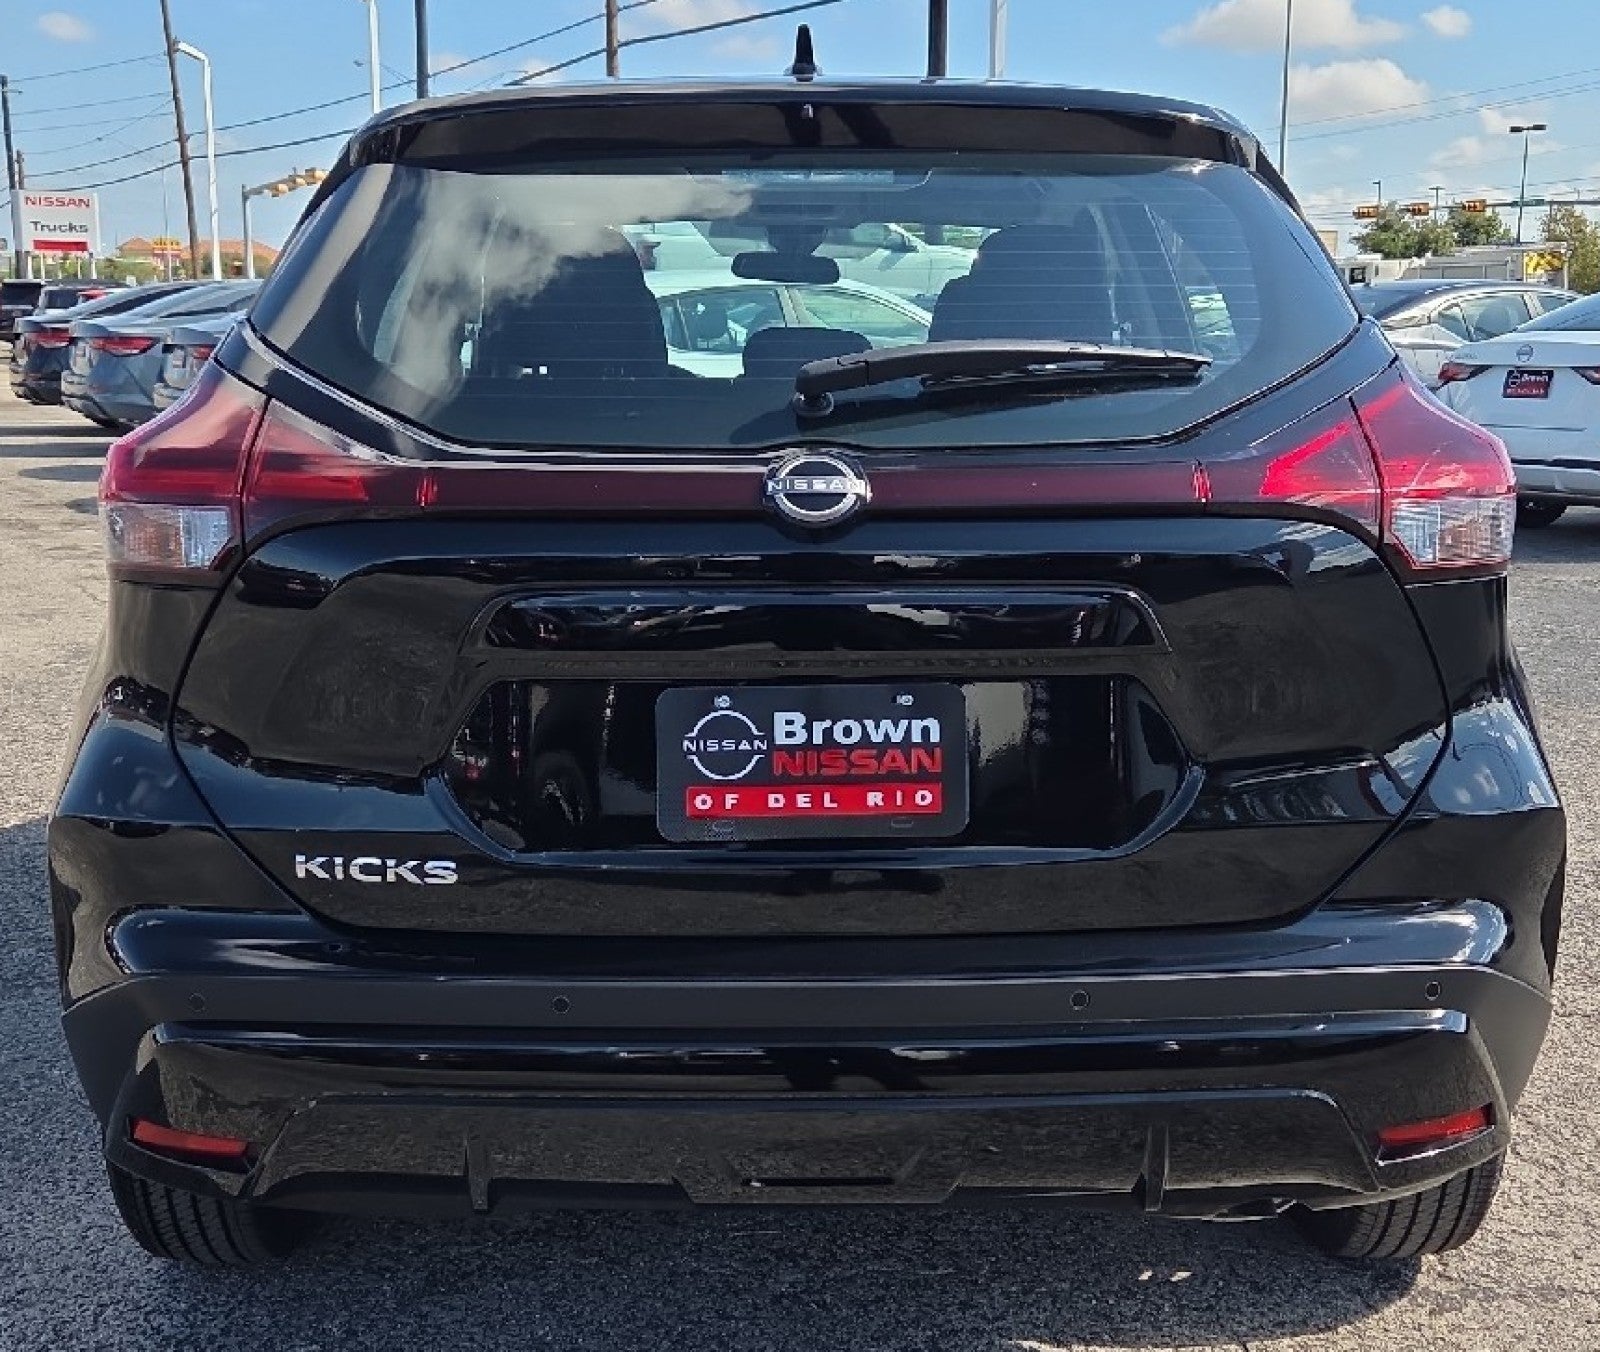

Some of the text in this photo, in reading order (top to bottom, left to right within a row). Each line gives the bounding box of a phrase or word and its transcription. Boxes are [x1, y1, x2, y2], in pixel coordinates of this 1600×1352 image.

[24, 196, 90, 208] NISSAN
[30, 221, 88, 233] Trucks
[766, 479, 866, 493] NISSAN
[773, 711, 941, 745] Brown
[682, 738, 768, 752] NISSAN
[773, 747, 943, 776] NISSAN
[694, 789, 934, 810] OF DEL RIO
[295, 854, 459, 885] KICKS
